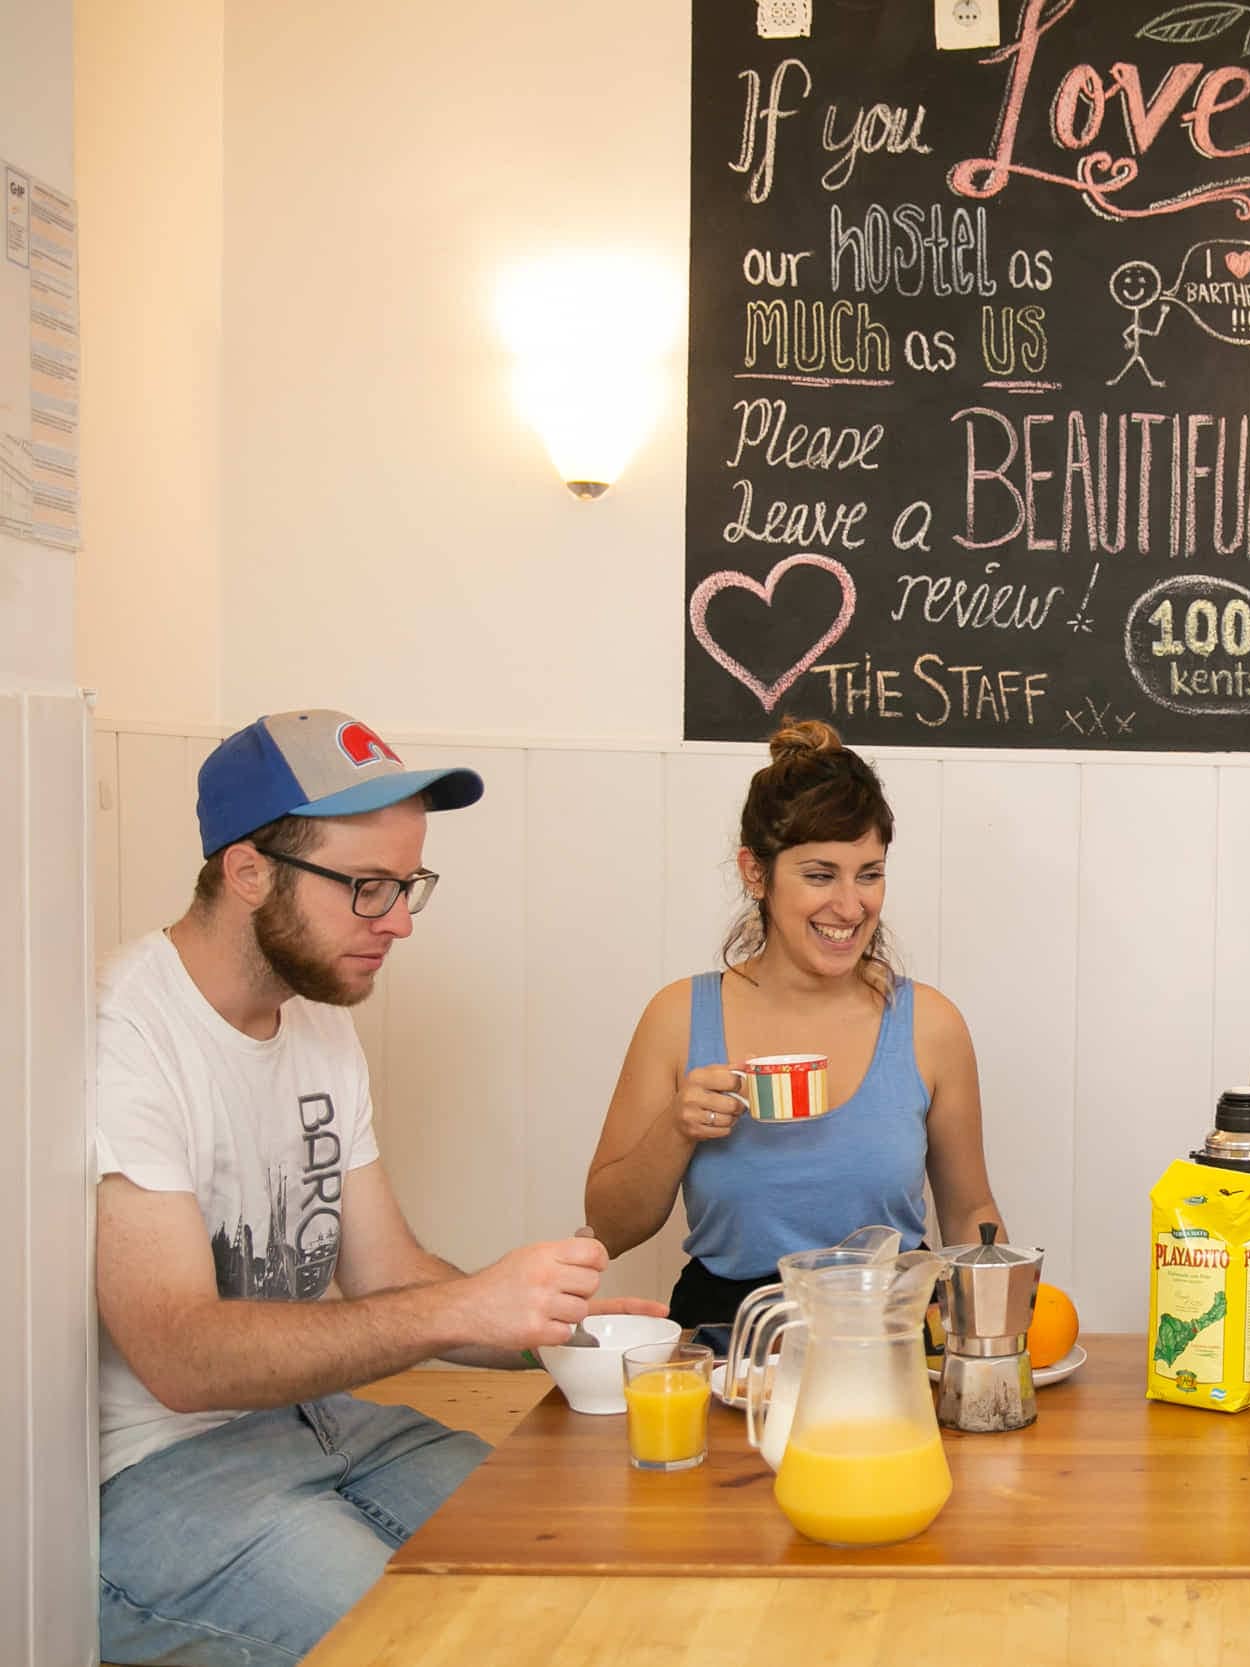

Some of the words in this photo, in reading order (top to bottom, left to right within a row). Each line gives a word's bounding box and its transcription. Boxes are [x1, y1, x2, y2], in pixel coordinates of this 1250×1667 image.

[728, 59, 811, 203] If
[822, 102, 933, 191] you
[743, 246, 811, 289] our
[1009, 250, 1054, 291] as
[1205, 248, 1212, 279] I
[904, 330, 956, 372] as
[981, 303, 1047, 375] US
[726, 398, 885, 470] Please
[723, 480, 868, 549] Leave
[893, 501, 933, 551] a
[915, 653, 1050, 727] STAFF
[1155, 1243, 1231, 1270] PLAYADITO
